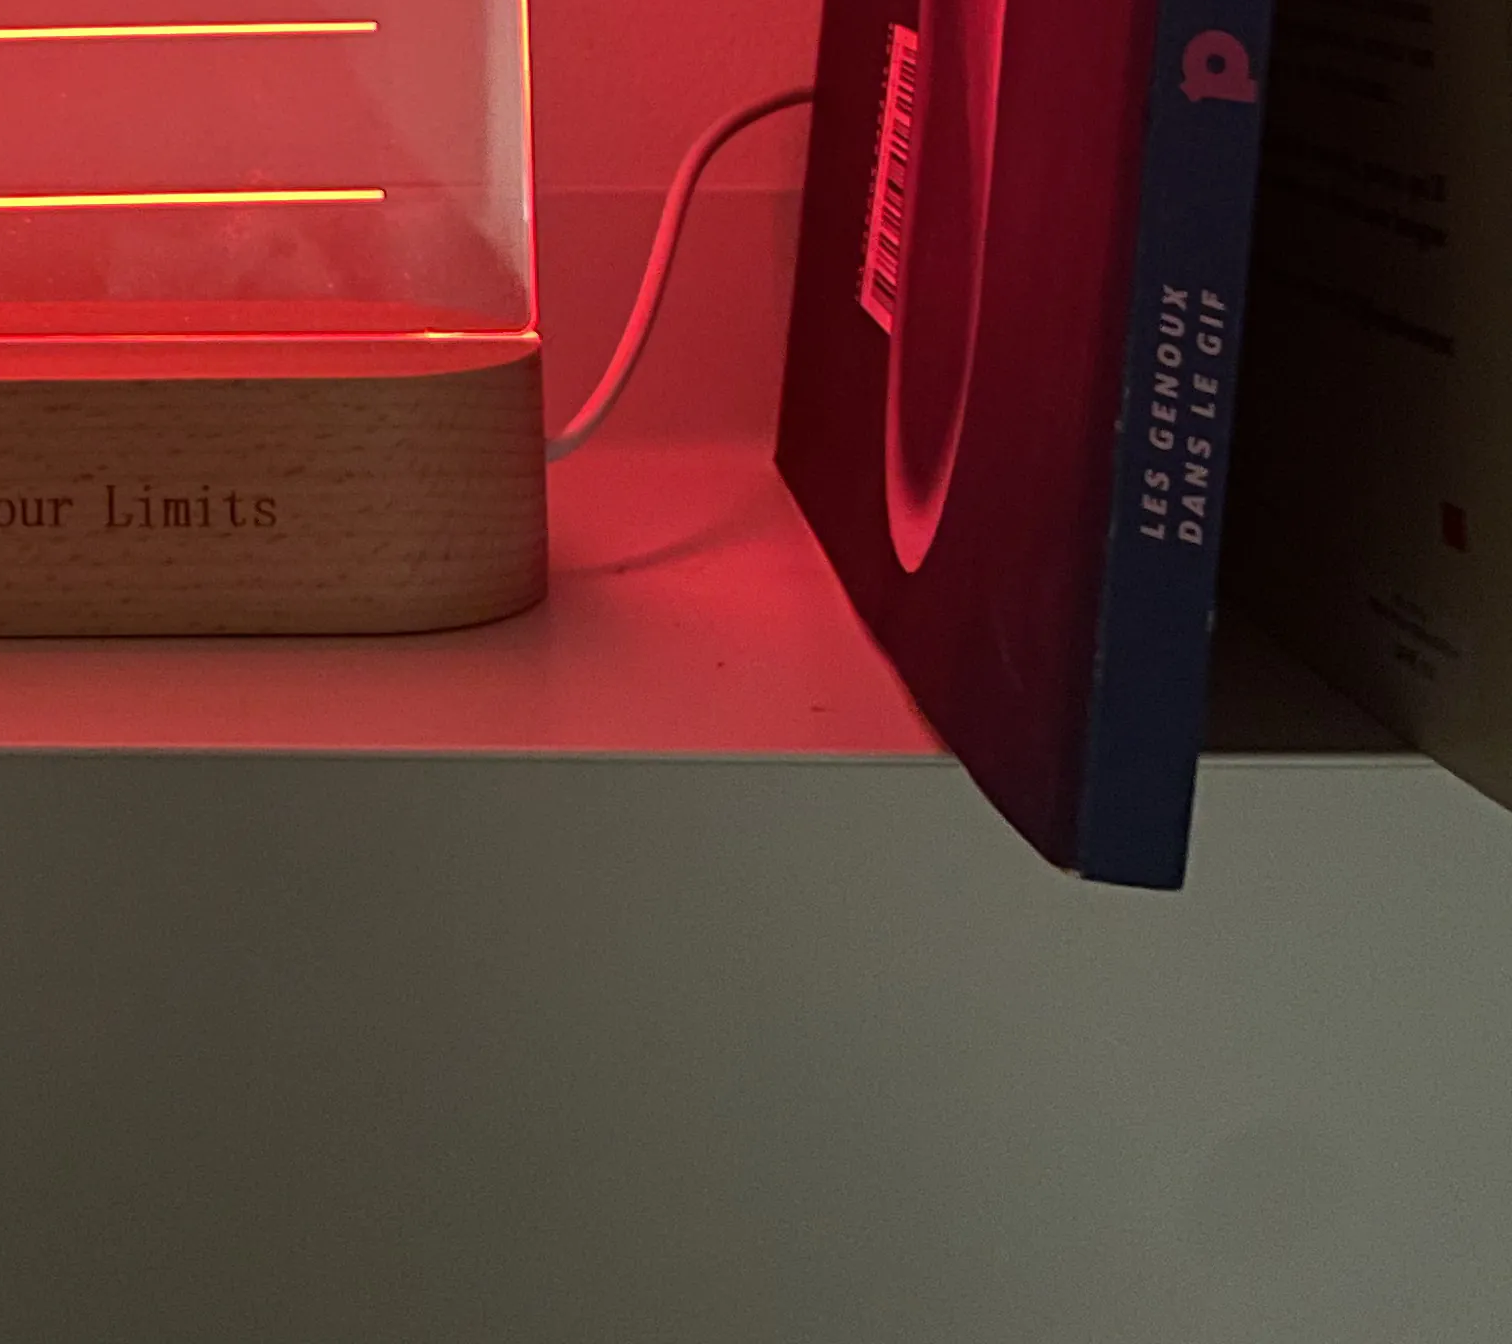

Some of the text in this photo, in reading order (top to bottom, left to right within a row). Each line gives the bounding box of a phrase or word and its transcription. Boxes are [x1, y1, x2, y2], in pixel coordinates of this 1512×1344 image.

[105, 484, 278, 529] Limits
[1139, 283, 1189, 541] LES GENOUX
[1178, 288, 1227, 546] DANS LE GIF
